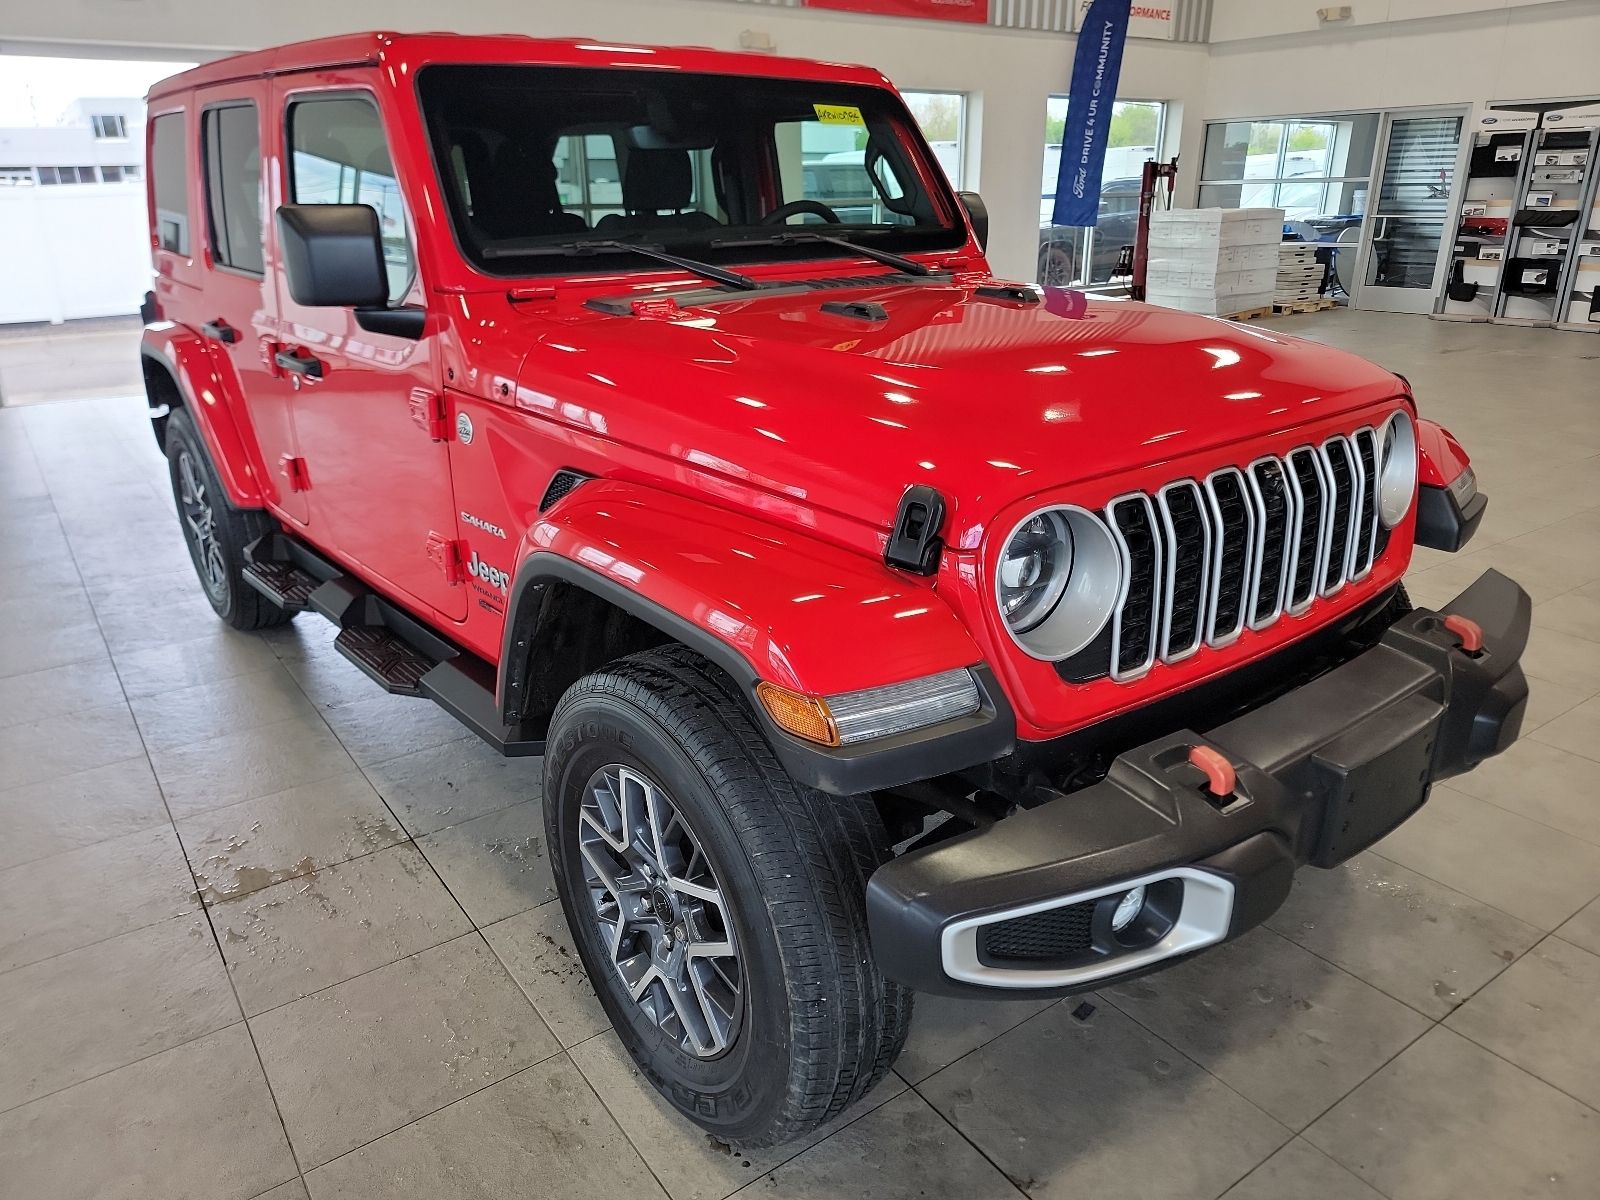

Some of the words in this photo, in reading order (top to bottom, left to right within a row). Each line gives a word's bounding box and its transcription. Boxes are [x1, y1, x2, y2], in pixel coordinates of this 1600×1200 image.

[1130, 6, 1171, 21] ORMANCE
[1092, 20, 1114, 97] COMMUNITY
[1087, 118, 1096, 126] 4
[1081, 128, 1094, 164] DRIVE
[1073, 168, 1088, 199] Ford
[461, 511, 507, 540] SAHARA
[466, 550, 510, 597] Jeep
